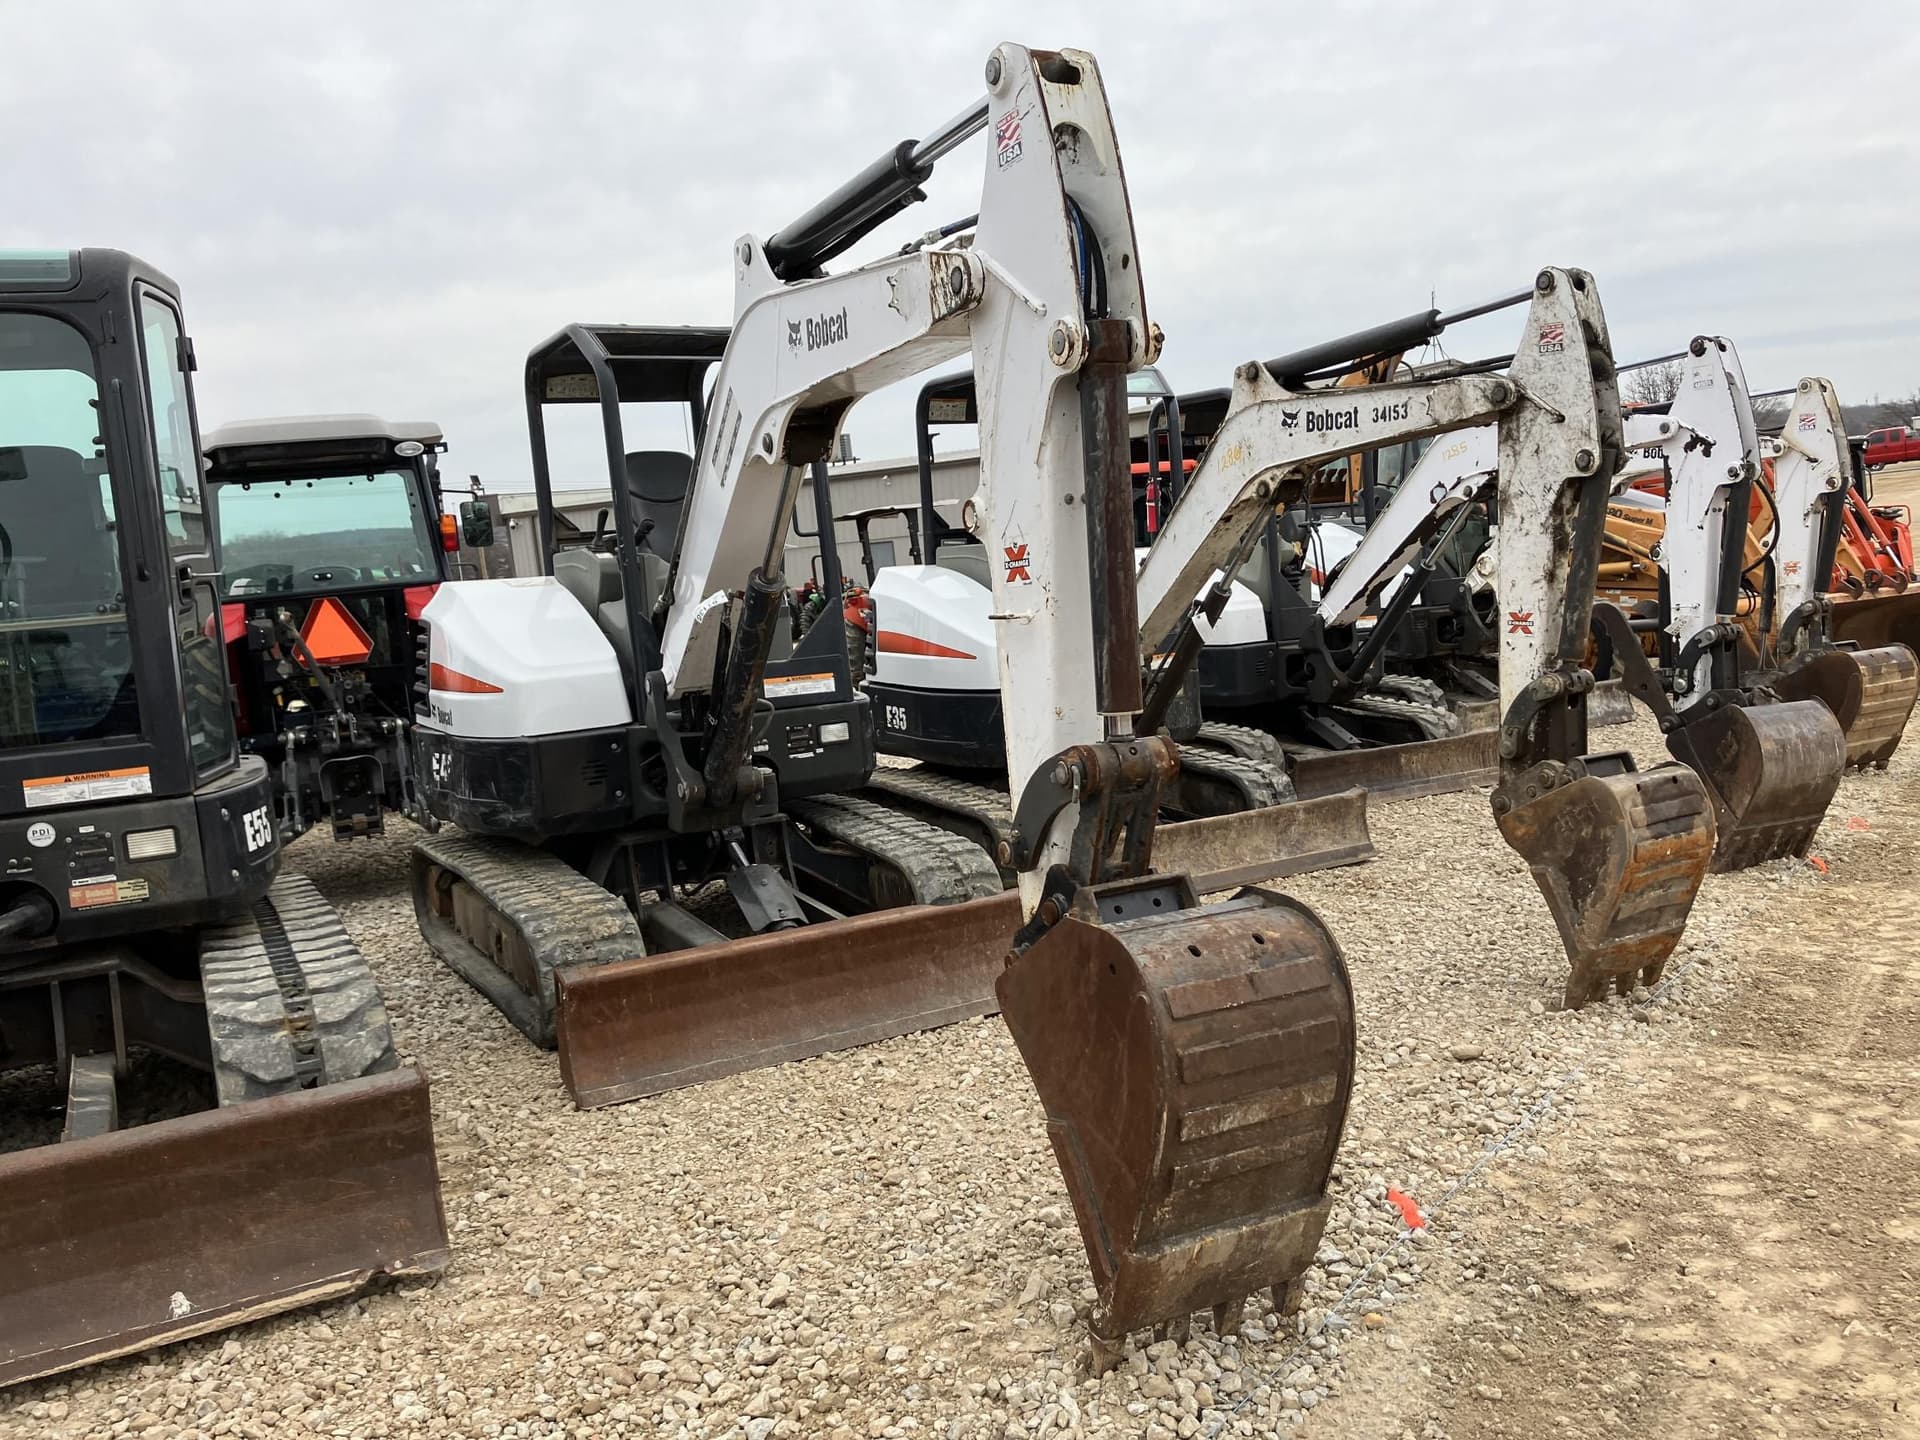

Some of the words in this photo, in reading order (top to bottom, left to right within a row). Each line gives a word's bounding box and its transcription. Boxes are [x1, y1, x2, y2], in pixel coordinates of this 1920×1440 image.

[999, 142, 1022, 166] USA
[806, 306, 849, 351] Bobcat
[1540, 343, 1563, 353] USA
[1306, 406, 1359, 433] Bobcat
[1372, 403, 1408, 423] 34153
[885, 705, 907, 730] E35
[73, 772, 111, 783] WARNING
[32, 828, 50, 838] PDI
[242, 805, 272, 852] E55
